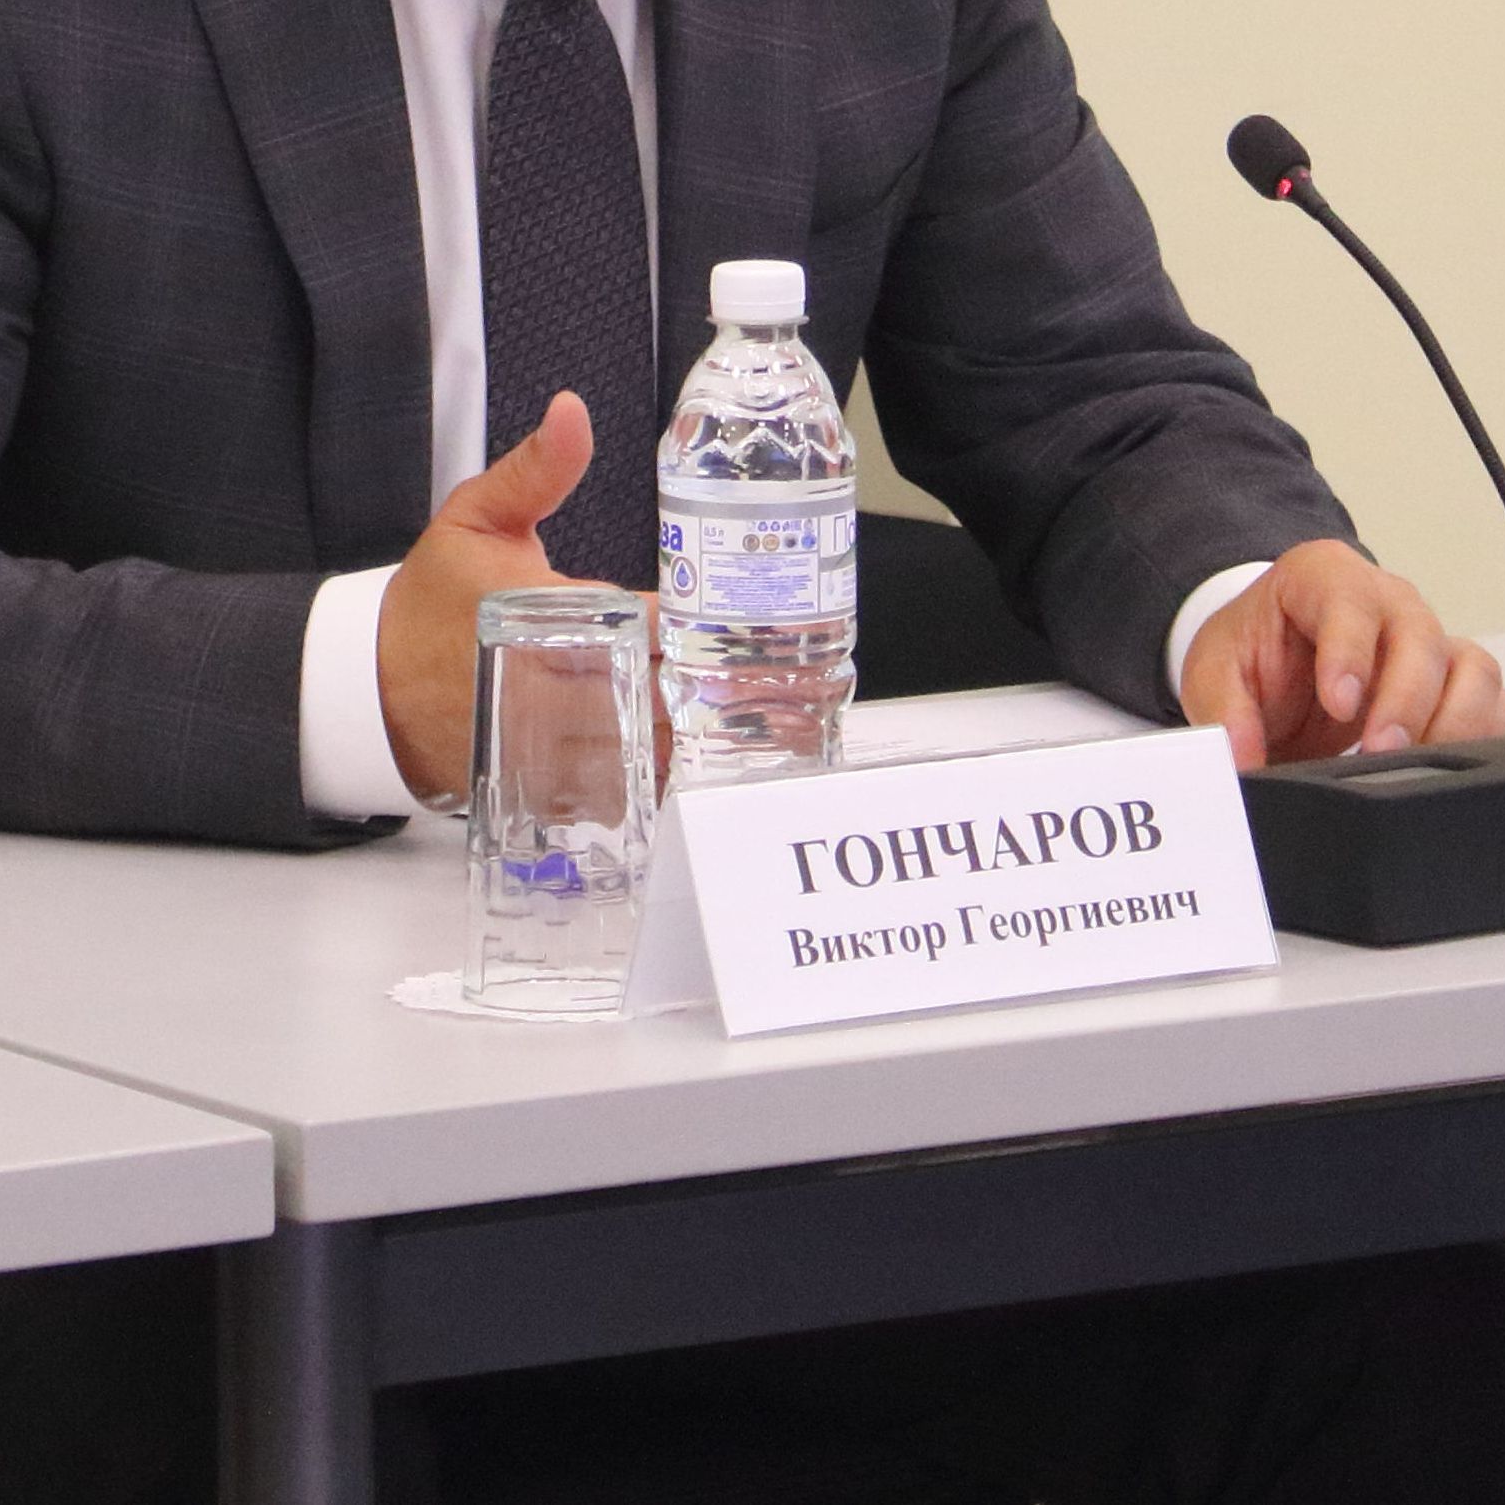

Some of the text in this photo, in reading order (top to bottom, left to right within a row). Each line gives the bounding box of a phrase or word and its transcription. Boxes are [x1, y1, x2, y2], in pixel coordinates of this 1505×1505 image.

[787, 799, 1163, 895] ГОНЧАРОВ
[786, 889, 1201, 969] Виктор Георгиевич
